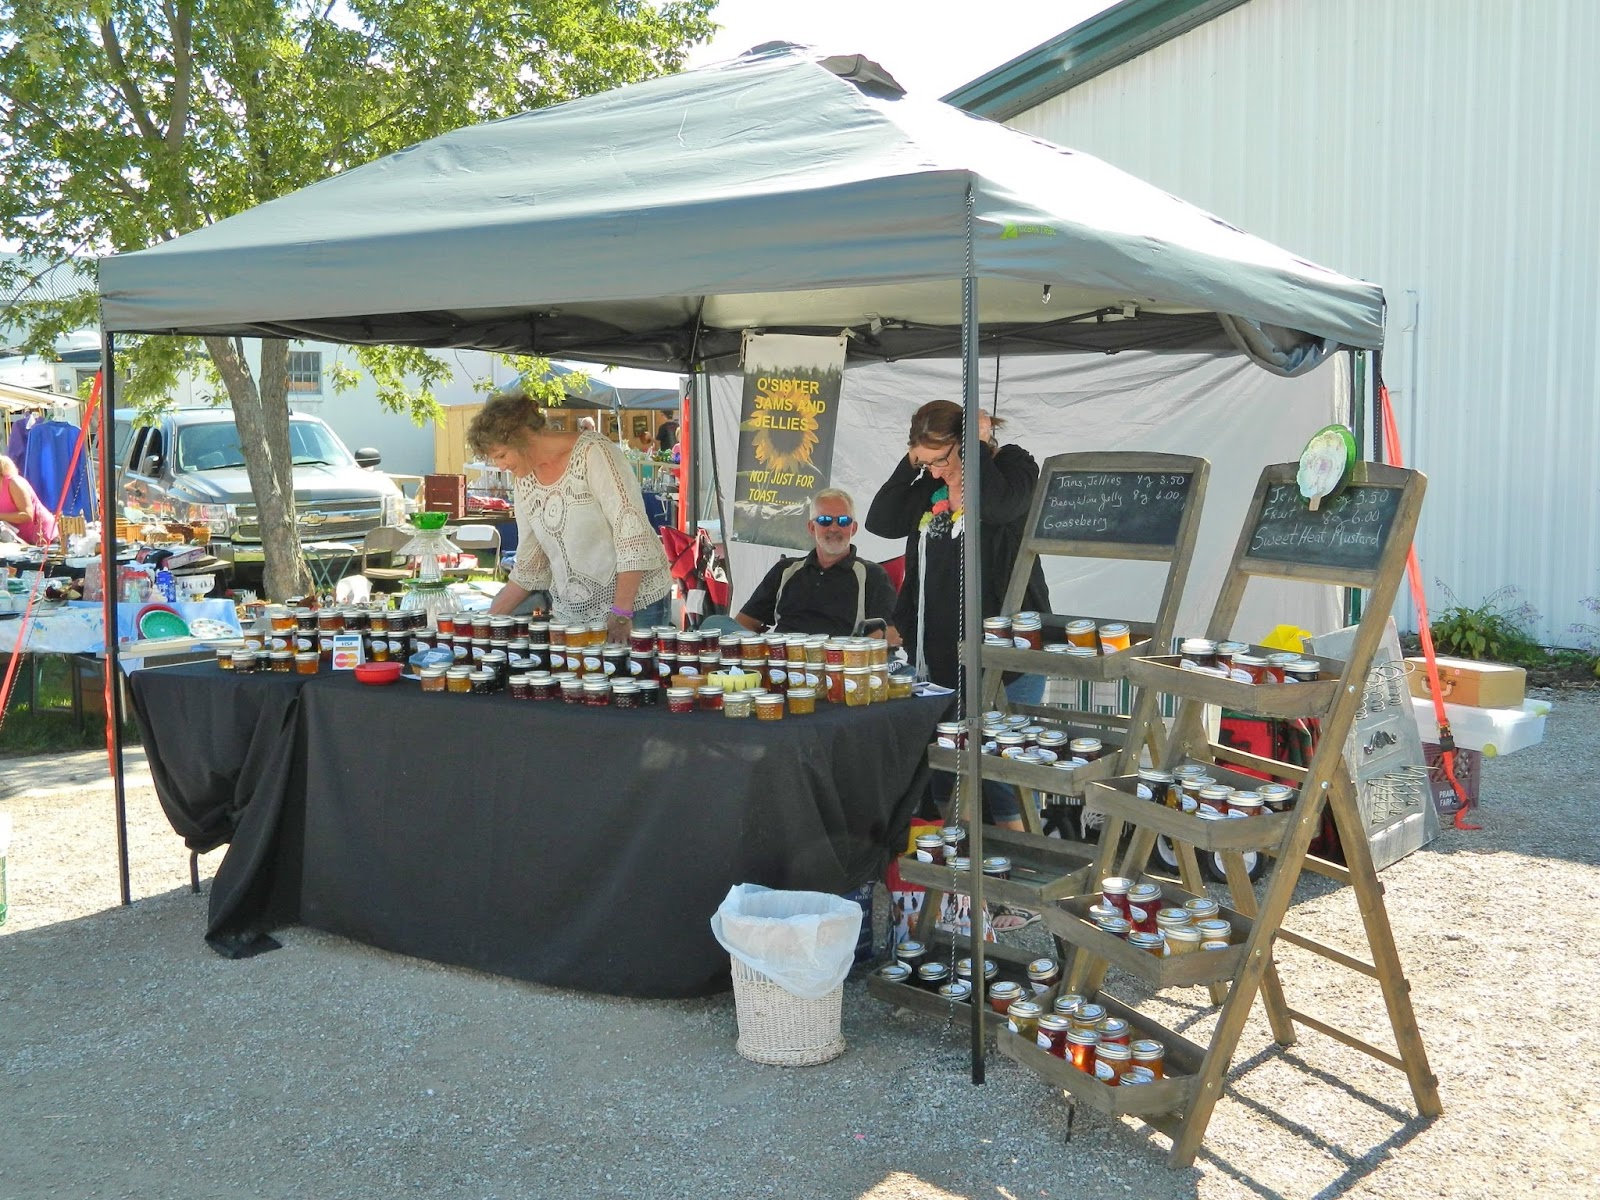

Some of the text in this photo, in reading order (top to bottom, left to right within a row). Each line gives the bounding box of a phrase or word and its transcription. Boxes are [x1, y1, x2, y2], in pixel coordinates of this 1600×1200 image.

[757, 377, 820, 394] O'SISTER
[755, 398, 826, 414] JAMS AND
[754, 415, 809, 431] JELLIES
[750, 469, 815, 488] NOT JUST FOR
[1160, 475, 1185, 485] 3.50
[1356, 489, 1389, 505] 3.50
[1043, 513, 1108, 532] Gooseberry
[1352, 509, 1380, 524] 6.00
[1252, 523, 1383, 551] Sweet Heat Mustard
